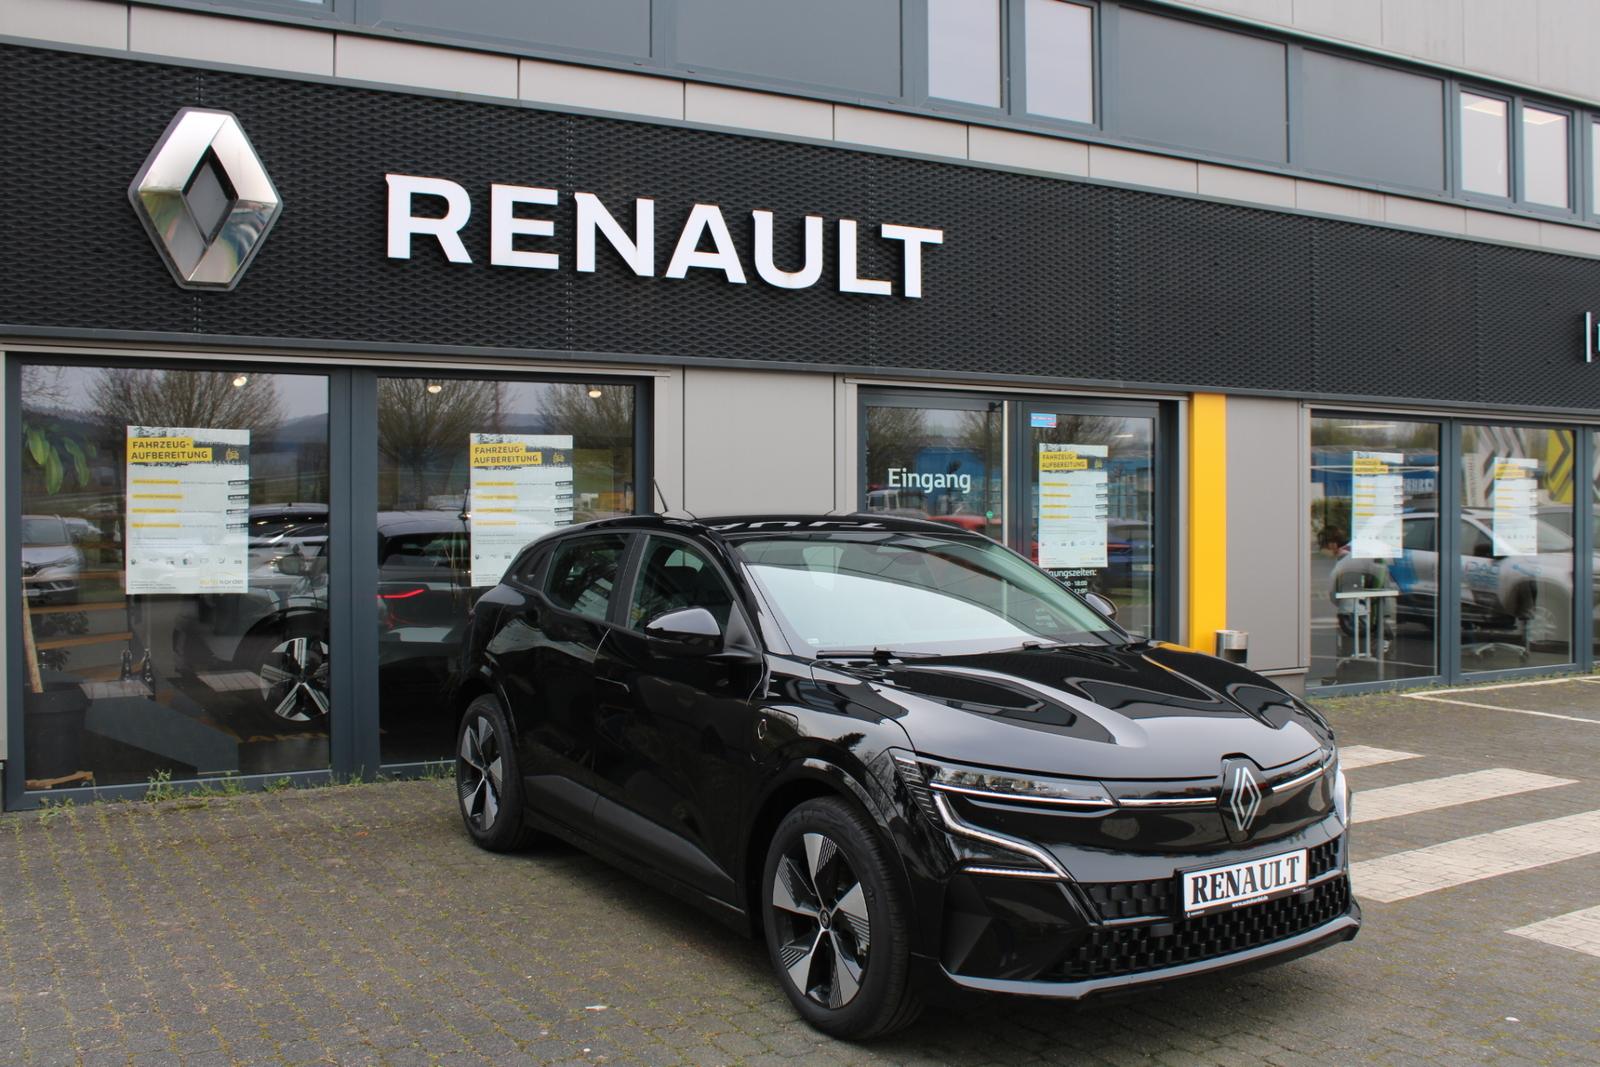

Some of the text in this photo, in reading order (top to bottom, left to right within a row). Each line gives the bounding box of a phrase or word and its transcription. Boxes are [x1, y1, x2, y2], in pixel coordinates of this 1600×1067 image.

[385, 173, 943, 298] RENAULT
[132, 440, 191, 450] FAHRZEUG-
[474, 445, 524, 454] FAHRZEUG-
[131, 450, 208, 460] AUFBEREITUNG
[473, 454, 538, 464] AUFBEREITUNG
[887, 467, 971, 494] Eingang
[1191, 856, 1300, 904] RENAULT
